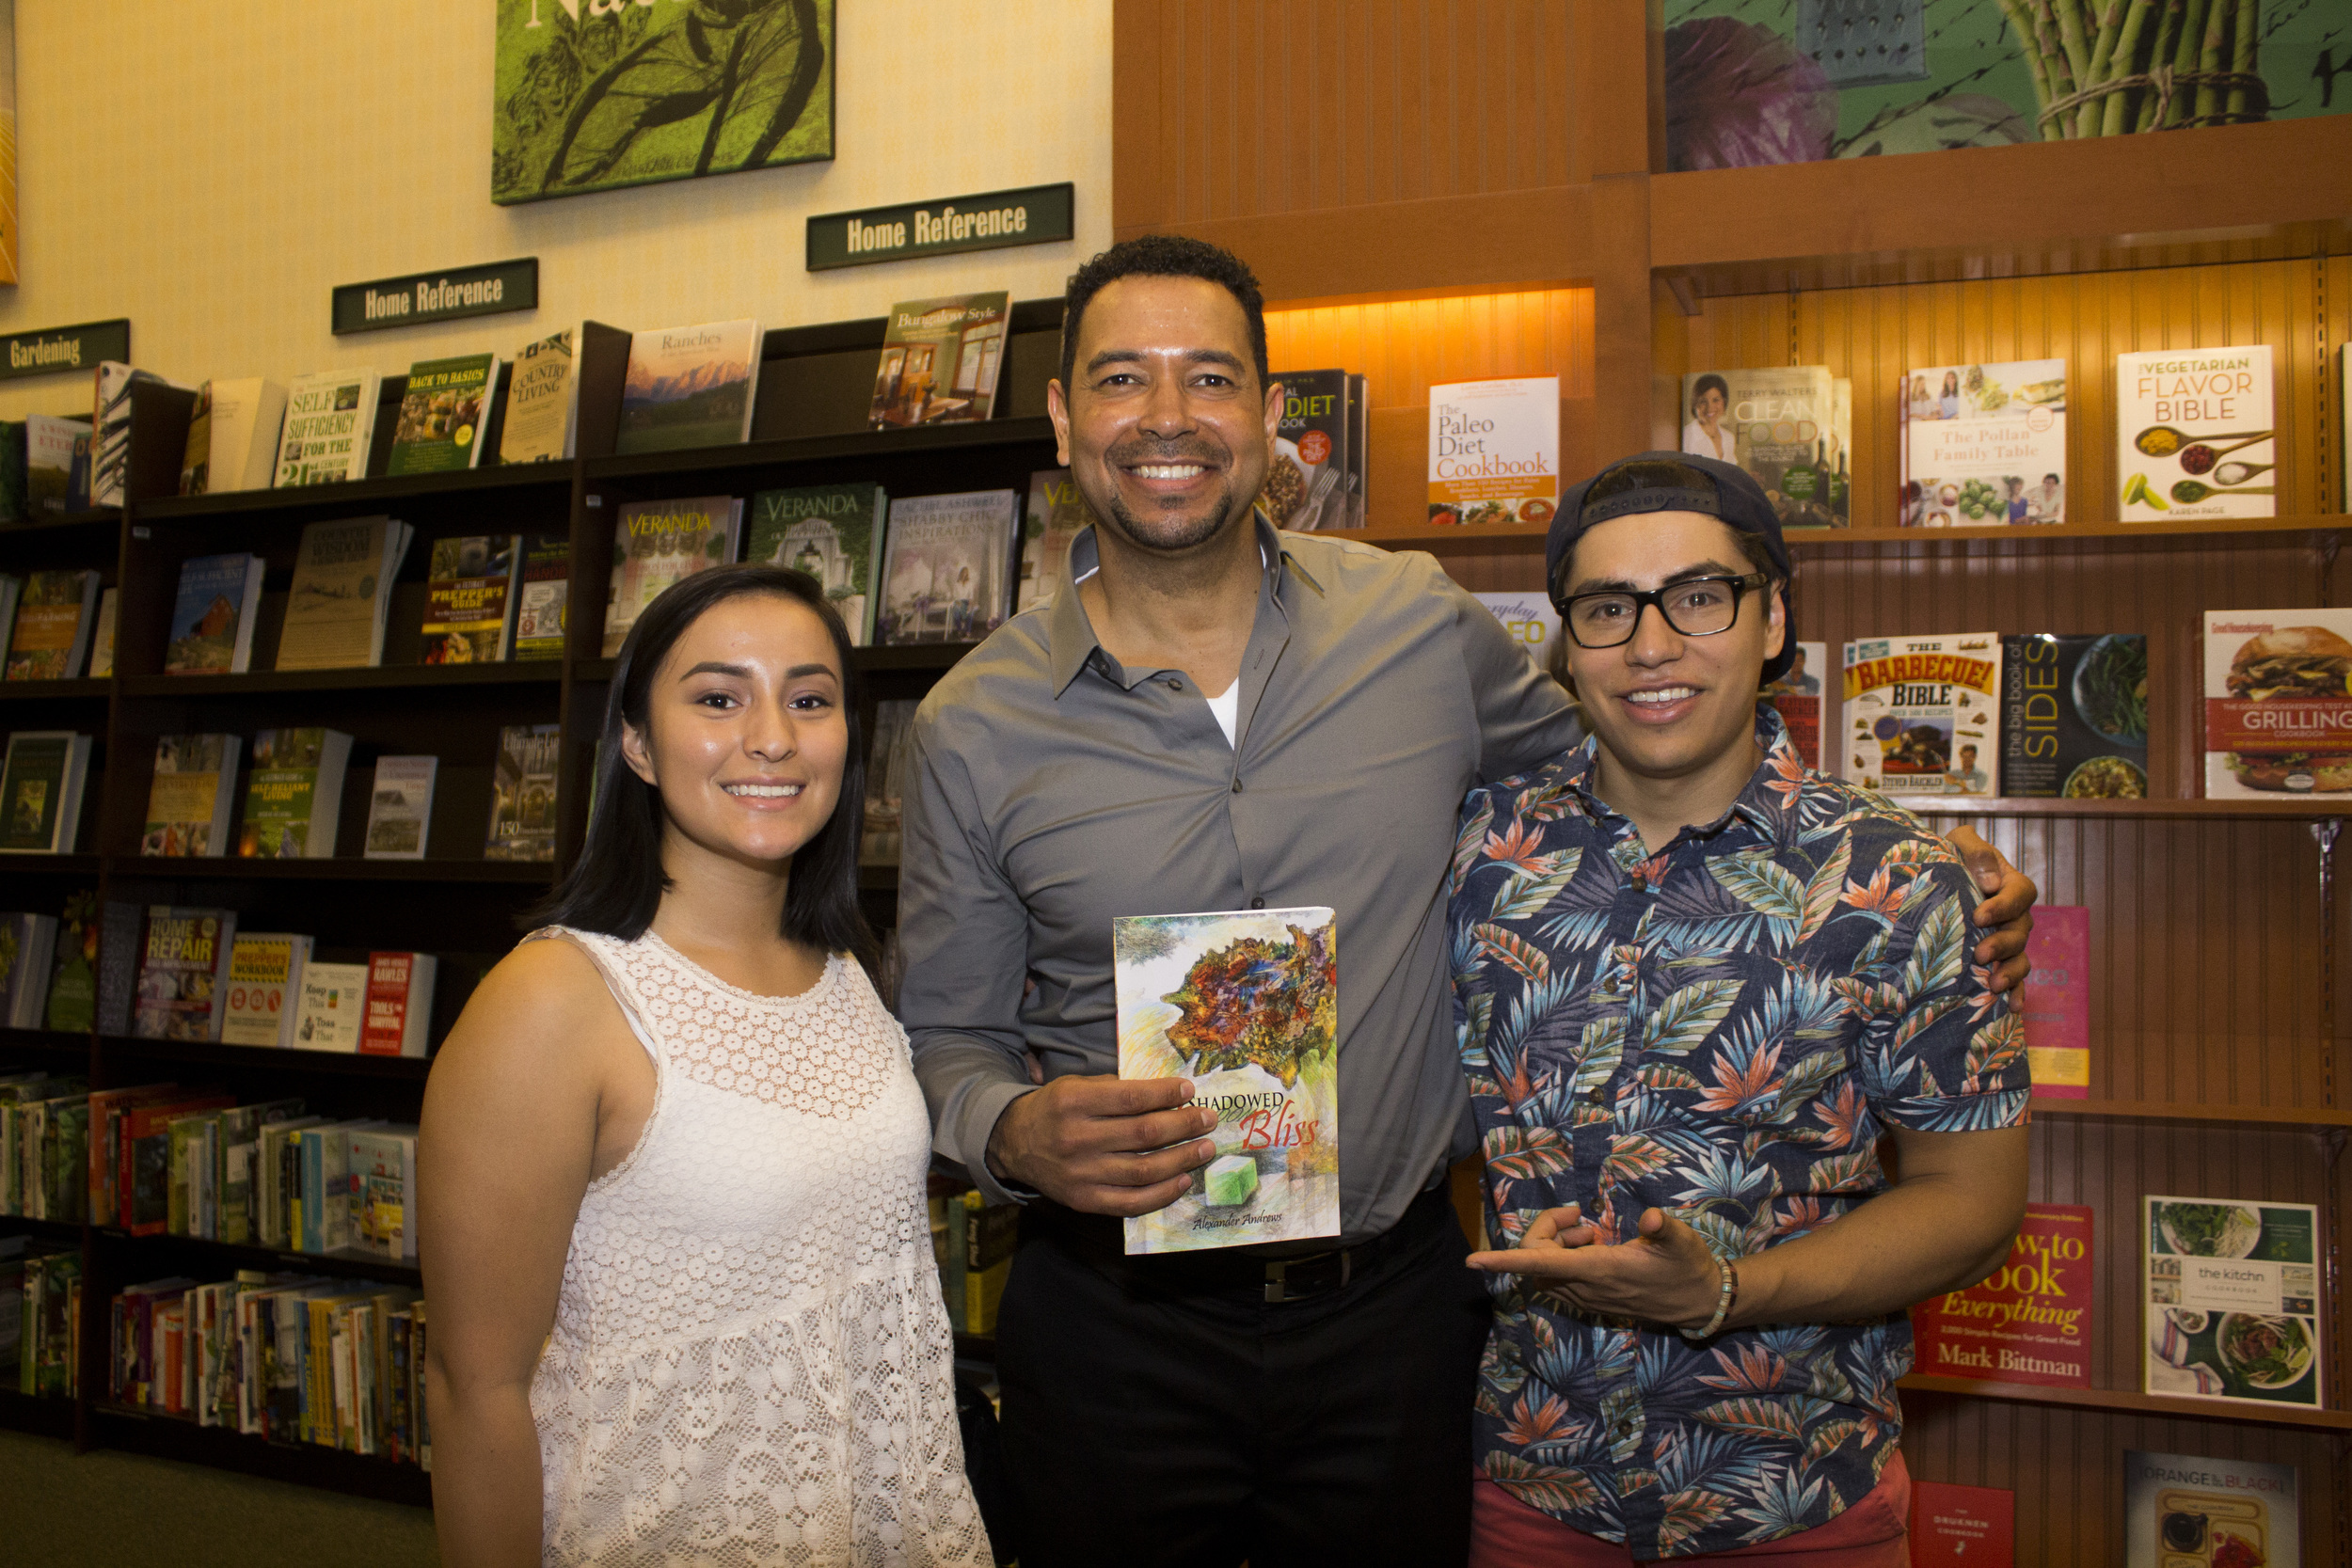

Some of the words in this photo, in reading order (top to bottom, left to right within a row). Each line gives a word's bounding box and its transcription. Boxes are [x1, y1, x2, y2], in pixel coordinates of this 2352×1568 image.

[848, 217, 905, 252] Home
[914, 206, 1026, 243] Reference
[365, 290, 409, 320] Home
[417, 278, 502, 311] Reference
[898, 309, 966, 328] Bungalow
[968, 307, 995, 322] Style
[662, 331, 722, 349] Ranches
[10, 336, 80, 368] Gardening
[2143, 357, 2249, 374] VEGETARIAN
[408, 374, 435, 388] BACK
[436, 373, 448, 386] TO
[450, 369, 485, 383] BASICS
[513, 364, 567, 393] COUNTRY
[2137, 372, 2251, 399] FLAVOR
[517, 378, 560, 403] LIVING
[1771, 387, 1818, 396] WALTERS
[292, 390, 335, 414] SELF
[1287, 395, 1336, 418] DIET
[1438, 404, 1460, 415] The
[1735, 400, 1817, 422] CLEAN
[2155, 398, 2235, 421] BIBLE
[288, 412, 357, 439] SUFFICIENCY
[1438, 414, 1494, 436] Paleo
[1736, 420, 1818, 444] FOOD
[1942, 431, 1973, 444] The
[1979, 428, 2030, 443] Pollan
[303, 441, 326, 456] FOR
[328, 438, 353, 453] THE
[1438, 436, 1486, 456] Diet
[1933, 446, 1987, 461] Family
[1994, 444, 2039, 458] Table
[320, 457, 349, 468] CENTURY
[1437, 451, 1549, 478] Cookbook
[766, 494, 858, 521] VERANDA
[628, 512, 711, 537] VERANDA
[431, 586, 504, 603] PREPPER'S
[452, 599, 483, 610] GUIDE
[1488, 600, 1538, 624] ryday
[1907, 642, 1942, 652] THE
[1856, 655, 1994, 690] BARBECUE!
[2008, 662, 2022, 701] book
[1892, 684, 1952, 706] BIBLE
[2025, 641, 2058, 758] SIDES
[2008, 704, 2024, 729] big
[2243, 711, 2352, 729] GRILLING
[2008, 732, 2023, 757] the
[500, 821, 519, 836] 150
[150, 918, 196, 937] HOME
[147, 937, 213, 961] REPAIR
[235, 952, 287, 964] PREPPER'S
[234, 963, 284, 976] WORKBOOK
[306, 983, 326, 996] Keep
[309, 998, 325, 1008] This
[315, 1017, 335, 1027] Toss
[316, 1030, 333, 1041] That
[1187, 1092, 1284, 1111] SHADOWED
[1239, 1100, 1319, 1149] Bliss
[1193, 1212, 1240, 1230] Alexander
[1242, 1210, 1282, 1226] Andrews
[2052, 1232, 2085, 1260] to
[1982, 1248, 2067, 1297] ook
[2199, 1267, 2220, 1278] the
[2223, 1268, 2265, 1281] kitchn
[1939, 1291, 2082, 1336] Everything
[1937, 1342, 1994, 1368] Mark
[1997, 1348, 2081, 1377] Bittman
[2144, 1466, 2210, 1486] ORANGE
[2225, 1474, 2279, 1492] BLACK
